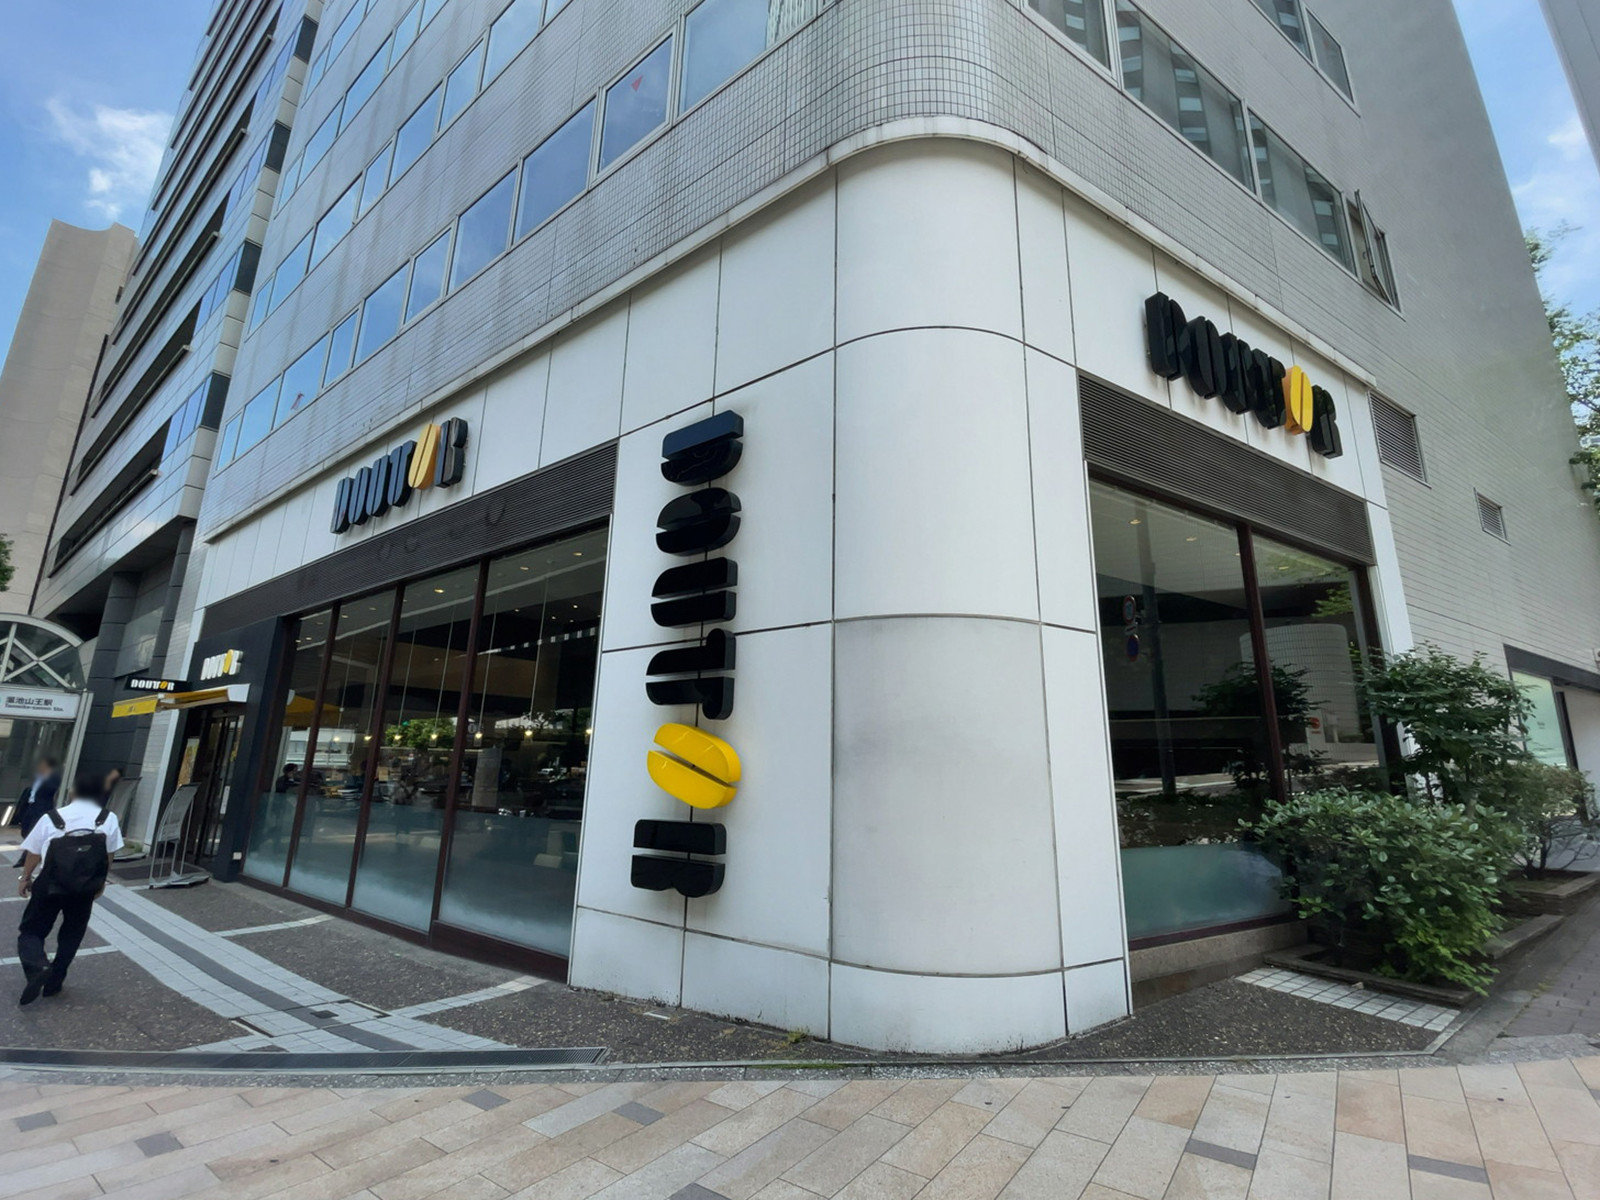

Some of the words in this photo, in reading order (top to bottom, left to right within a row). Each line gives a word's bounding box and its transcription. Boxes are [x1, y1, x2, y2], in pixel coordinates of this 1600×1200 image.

[1145, 291, 1343, 459] DOUTOR
[330, 416, 468, 535] DOUTOR
[130, 678, 175, 691] DOUTOR
[630, 409, 744, 898] DOUTOR
